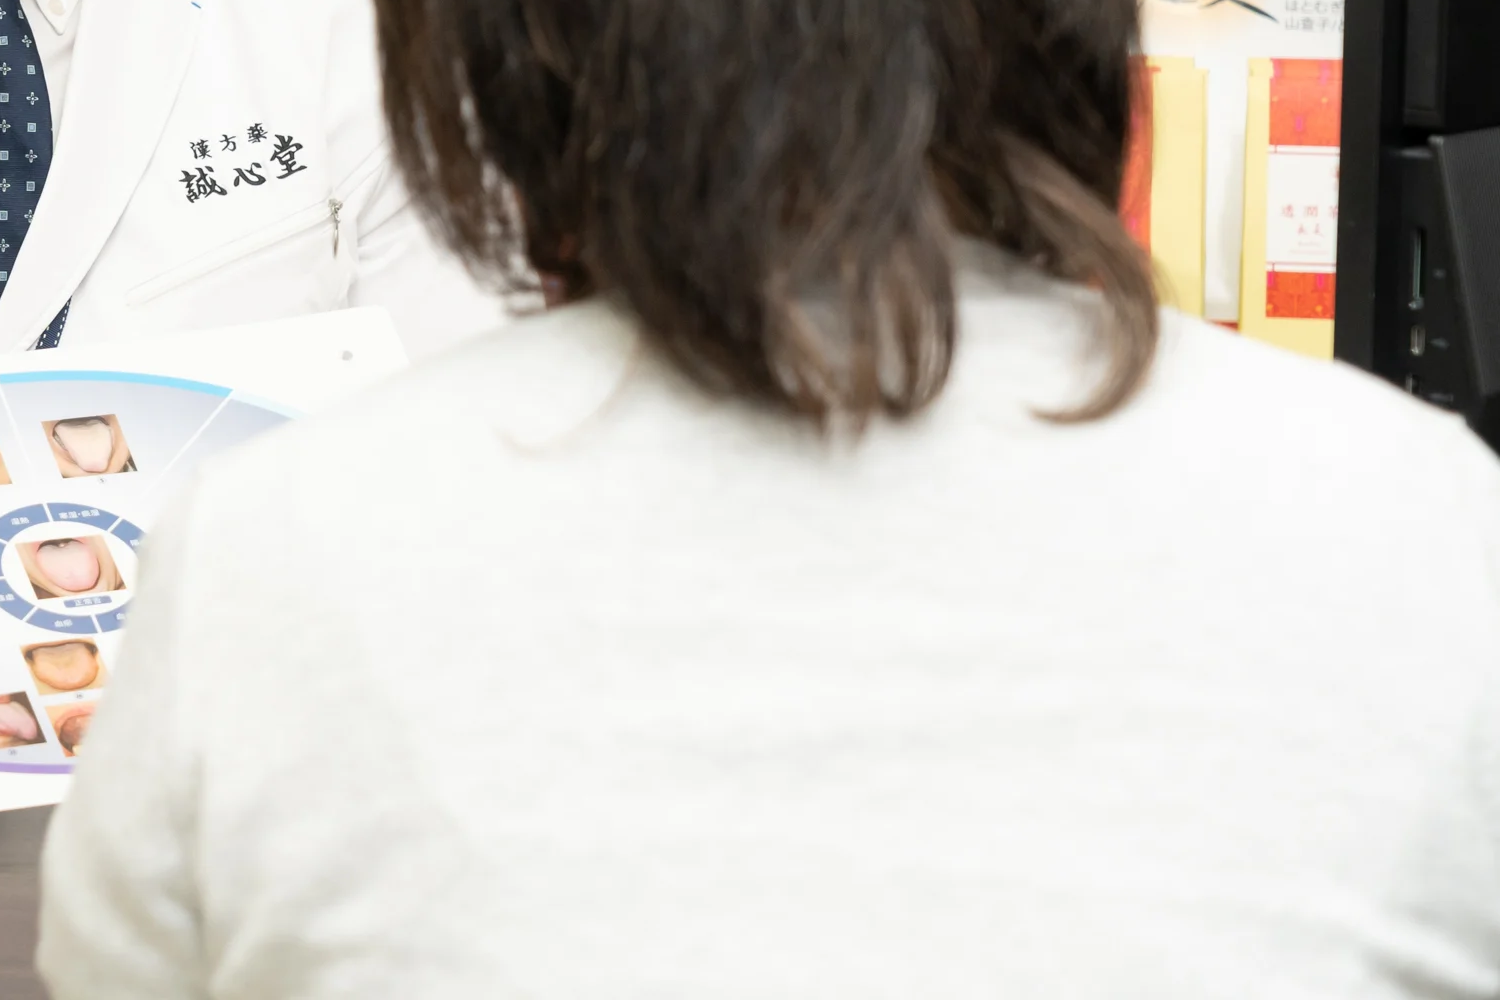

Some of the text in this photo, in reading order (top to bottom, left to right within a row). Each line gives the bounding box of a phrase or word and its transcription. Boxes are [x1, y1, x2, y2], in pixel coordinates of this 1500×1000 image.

[190, 123, 268, 160] 漢方薬
[179, 134, 308, 204] 誠心堂
